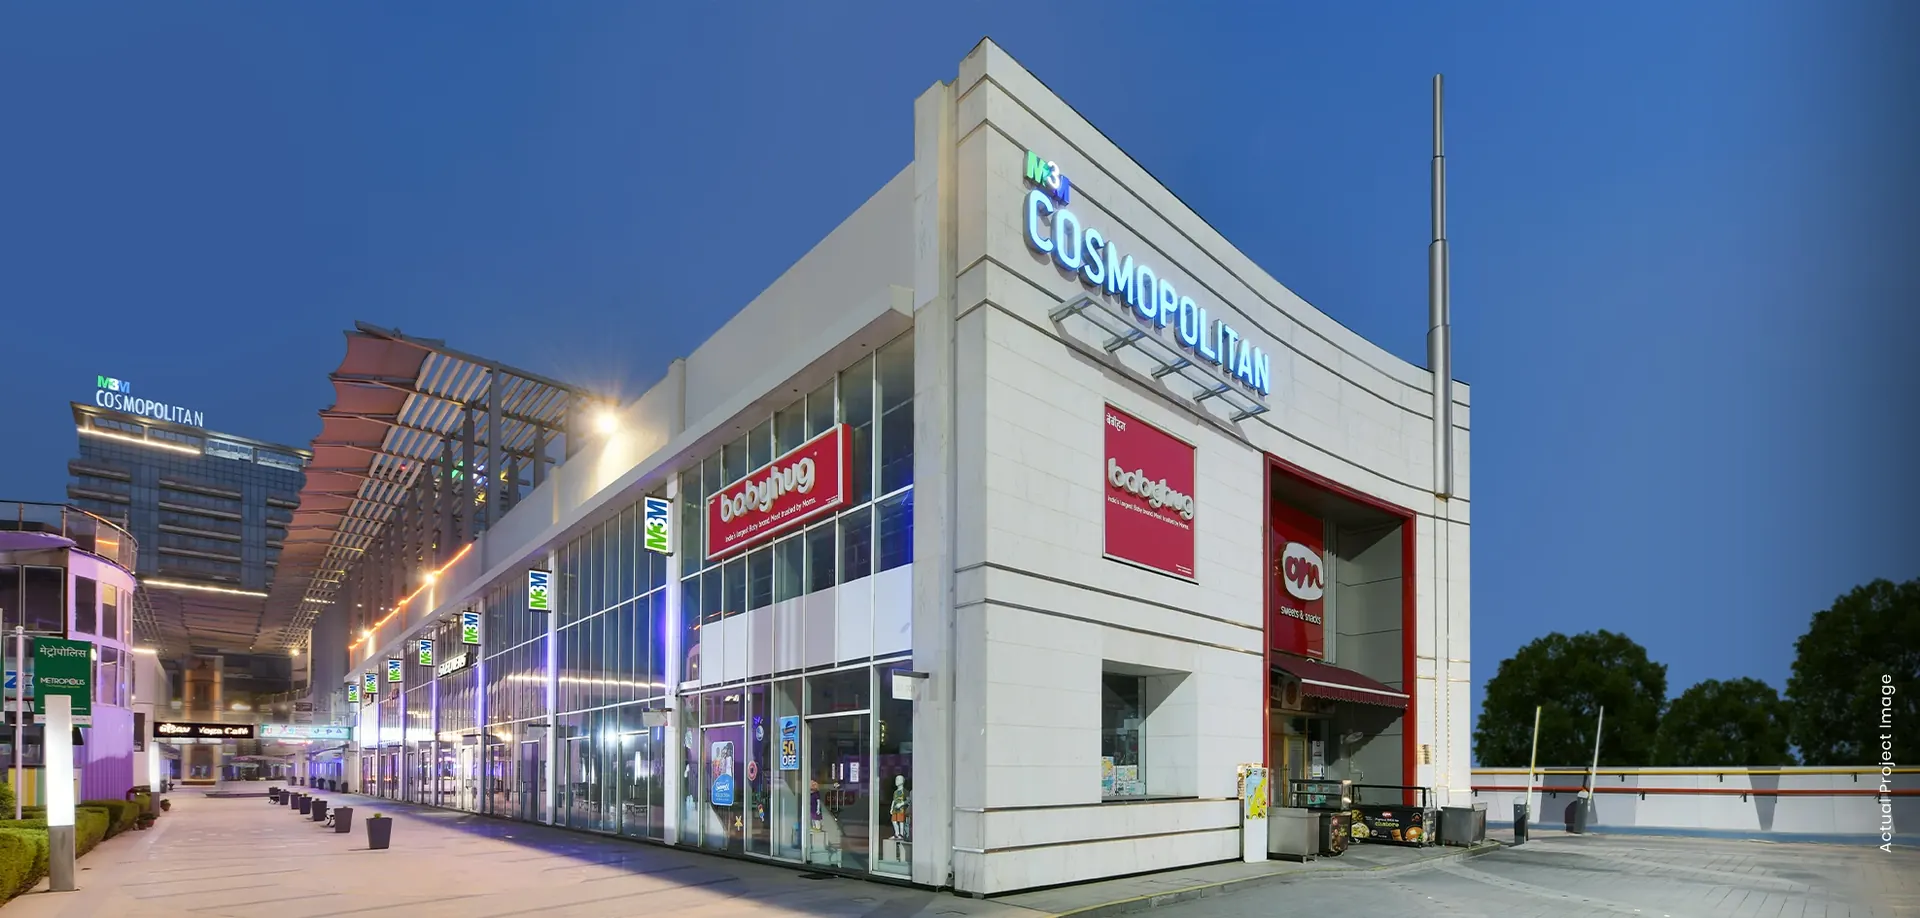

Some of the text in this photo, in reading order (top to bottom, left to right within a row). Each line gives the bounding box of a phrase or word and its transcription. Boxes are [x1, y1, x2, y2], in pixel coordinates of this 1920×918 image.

[1026, 150, 1070, 205] M3M
[1025, 189, 1270, 396] COSMOPOLITAN
[97, 375, 131, 394] M3M
[96, 389, 204, 428] COSMOPOLITAN
[720, 457, 816, 523] babyhug
[1107, 458, 1194, 520] babyhug
[647, 499, 668, 551] M3M
[530, 572, 548, 609] M3M
[464, 613, 478, 643] M3M
[1280, 605, 1322, 625] sweets & snacks
[40, 644, 88, 658] मेट्रोपोलिस
[421, 640, 432, 665] M3M
[40, 677, 86, 686] METROPOLIS
[389, 660, 400, 681] M3M
[782, 755, 797, 767] OFF
